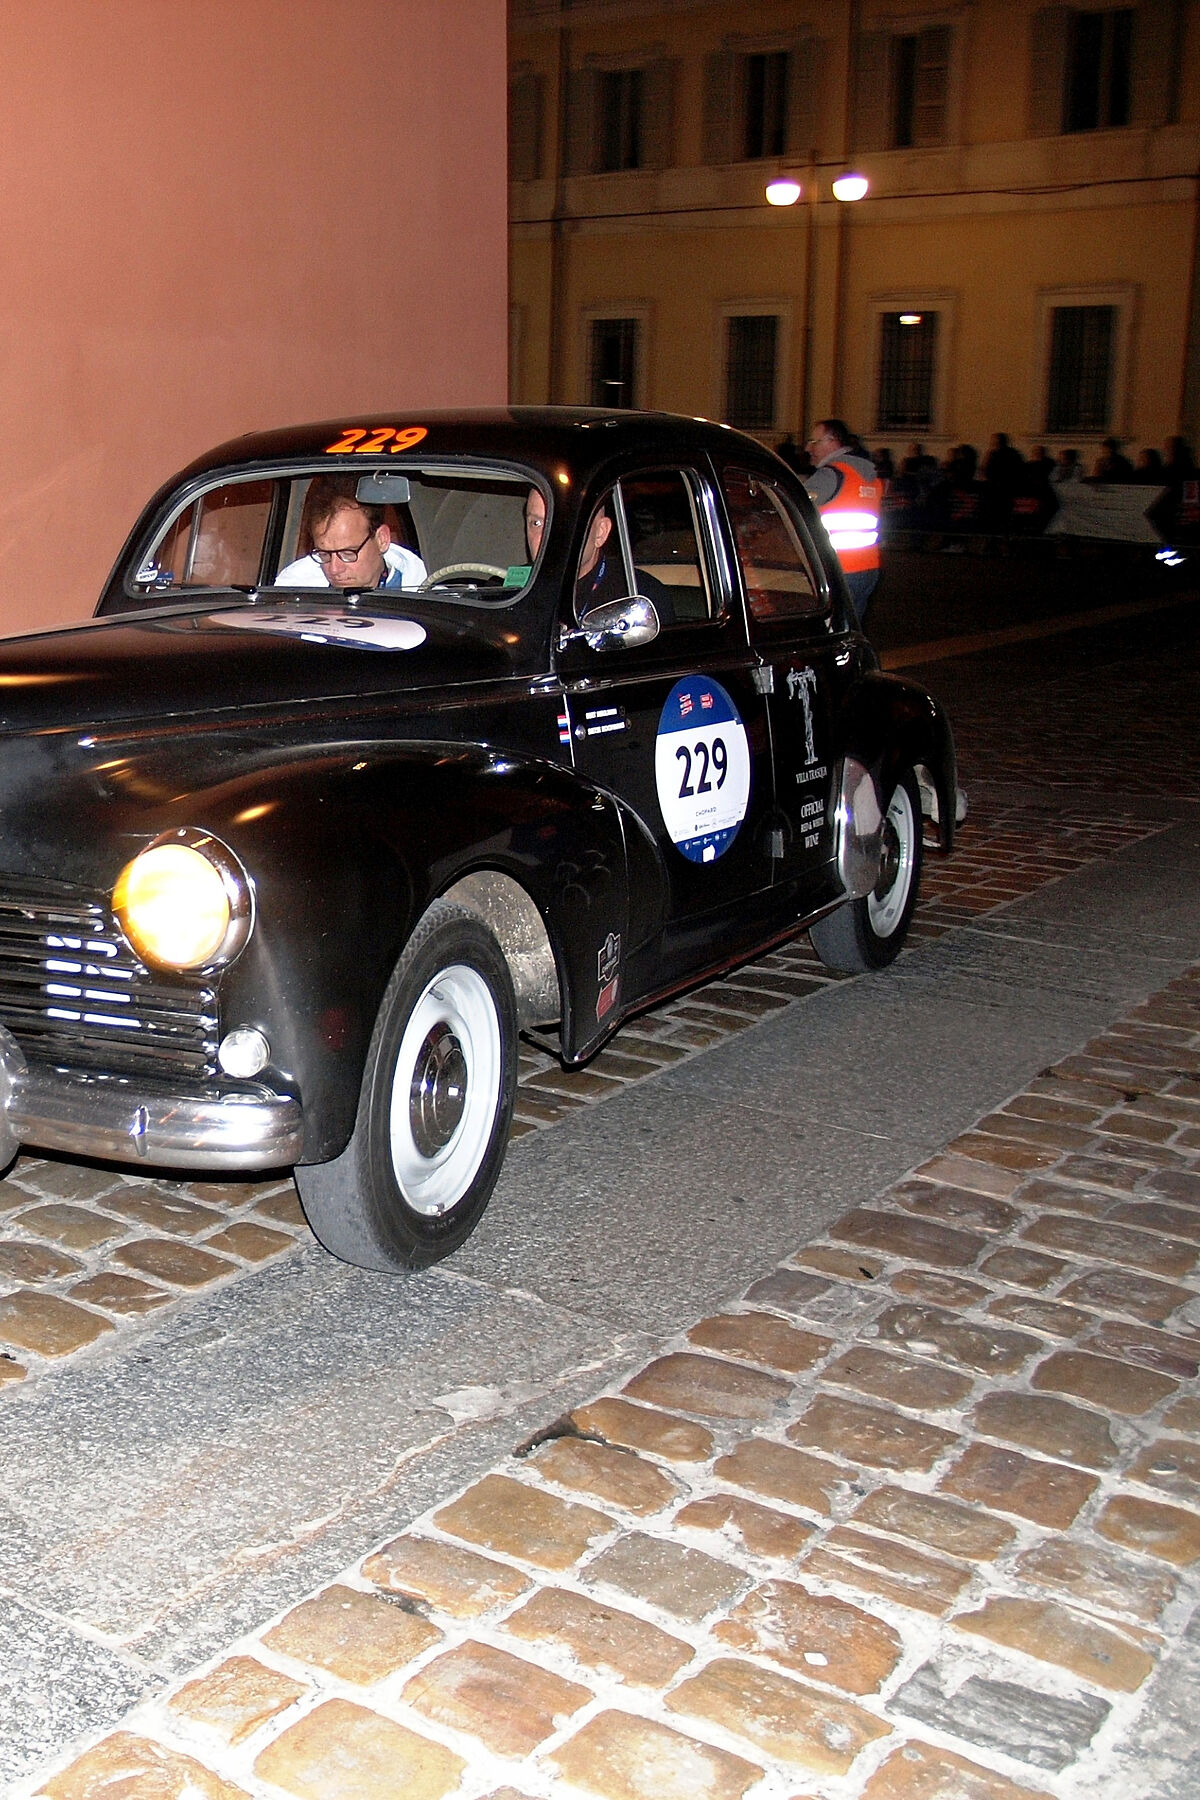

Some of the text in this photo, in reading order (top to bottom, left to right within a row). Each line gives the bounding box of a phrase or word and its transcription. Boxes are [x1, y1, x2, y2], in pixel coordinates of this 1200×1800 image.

[326, 427, 428, 453] 229
[253, 614, 375, 628] 229
[675, 737, 728, 798] 229
